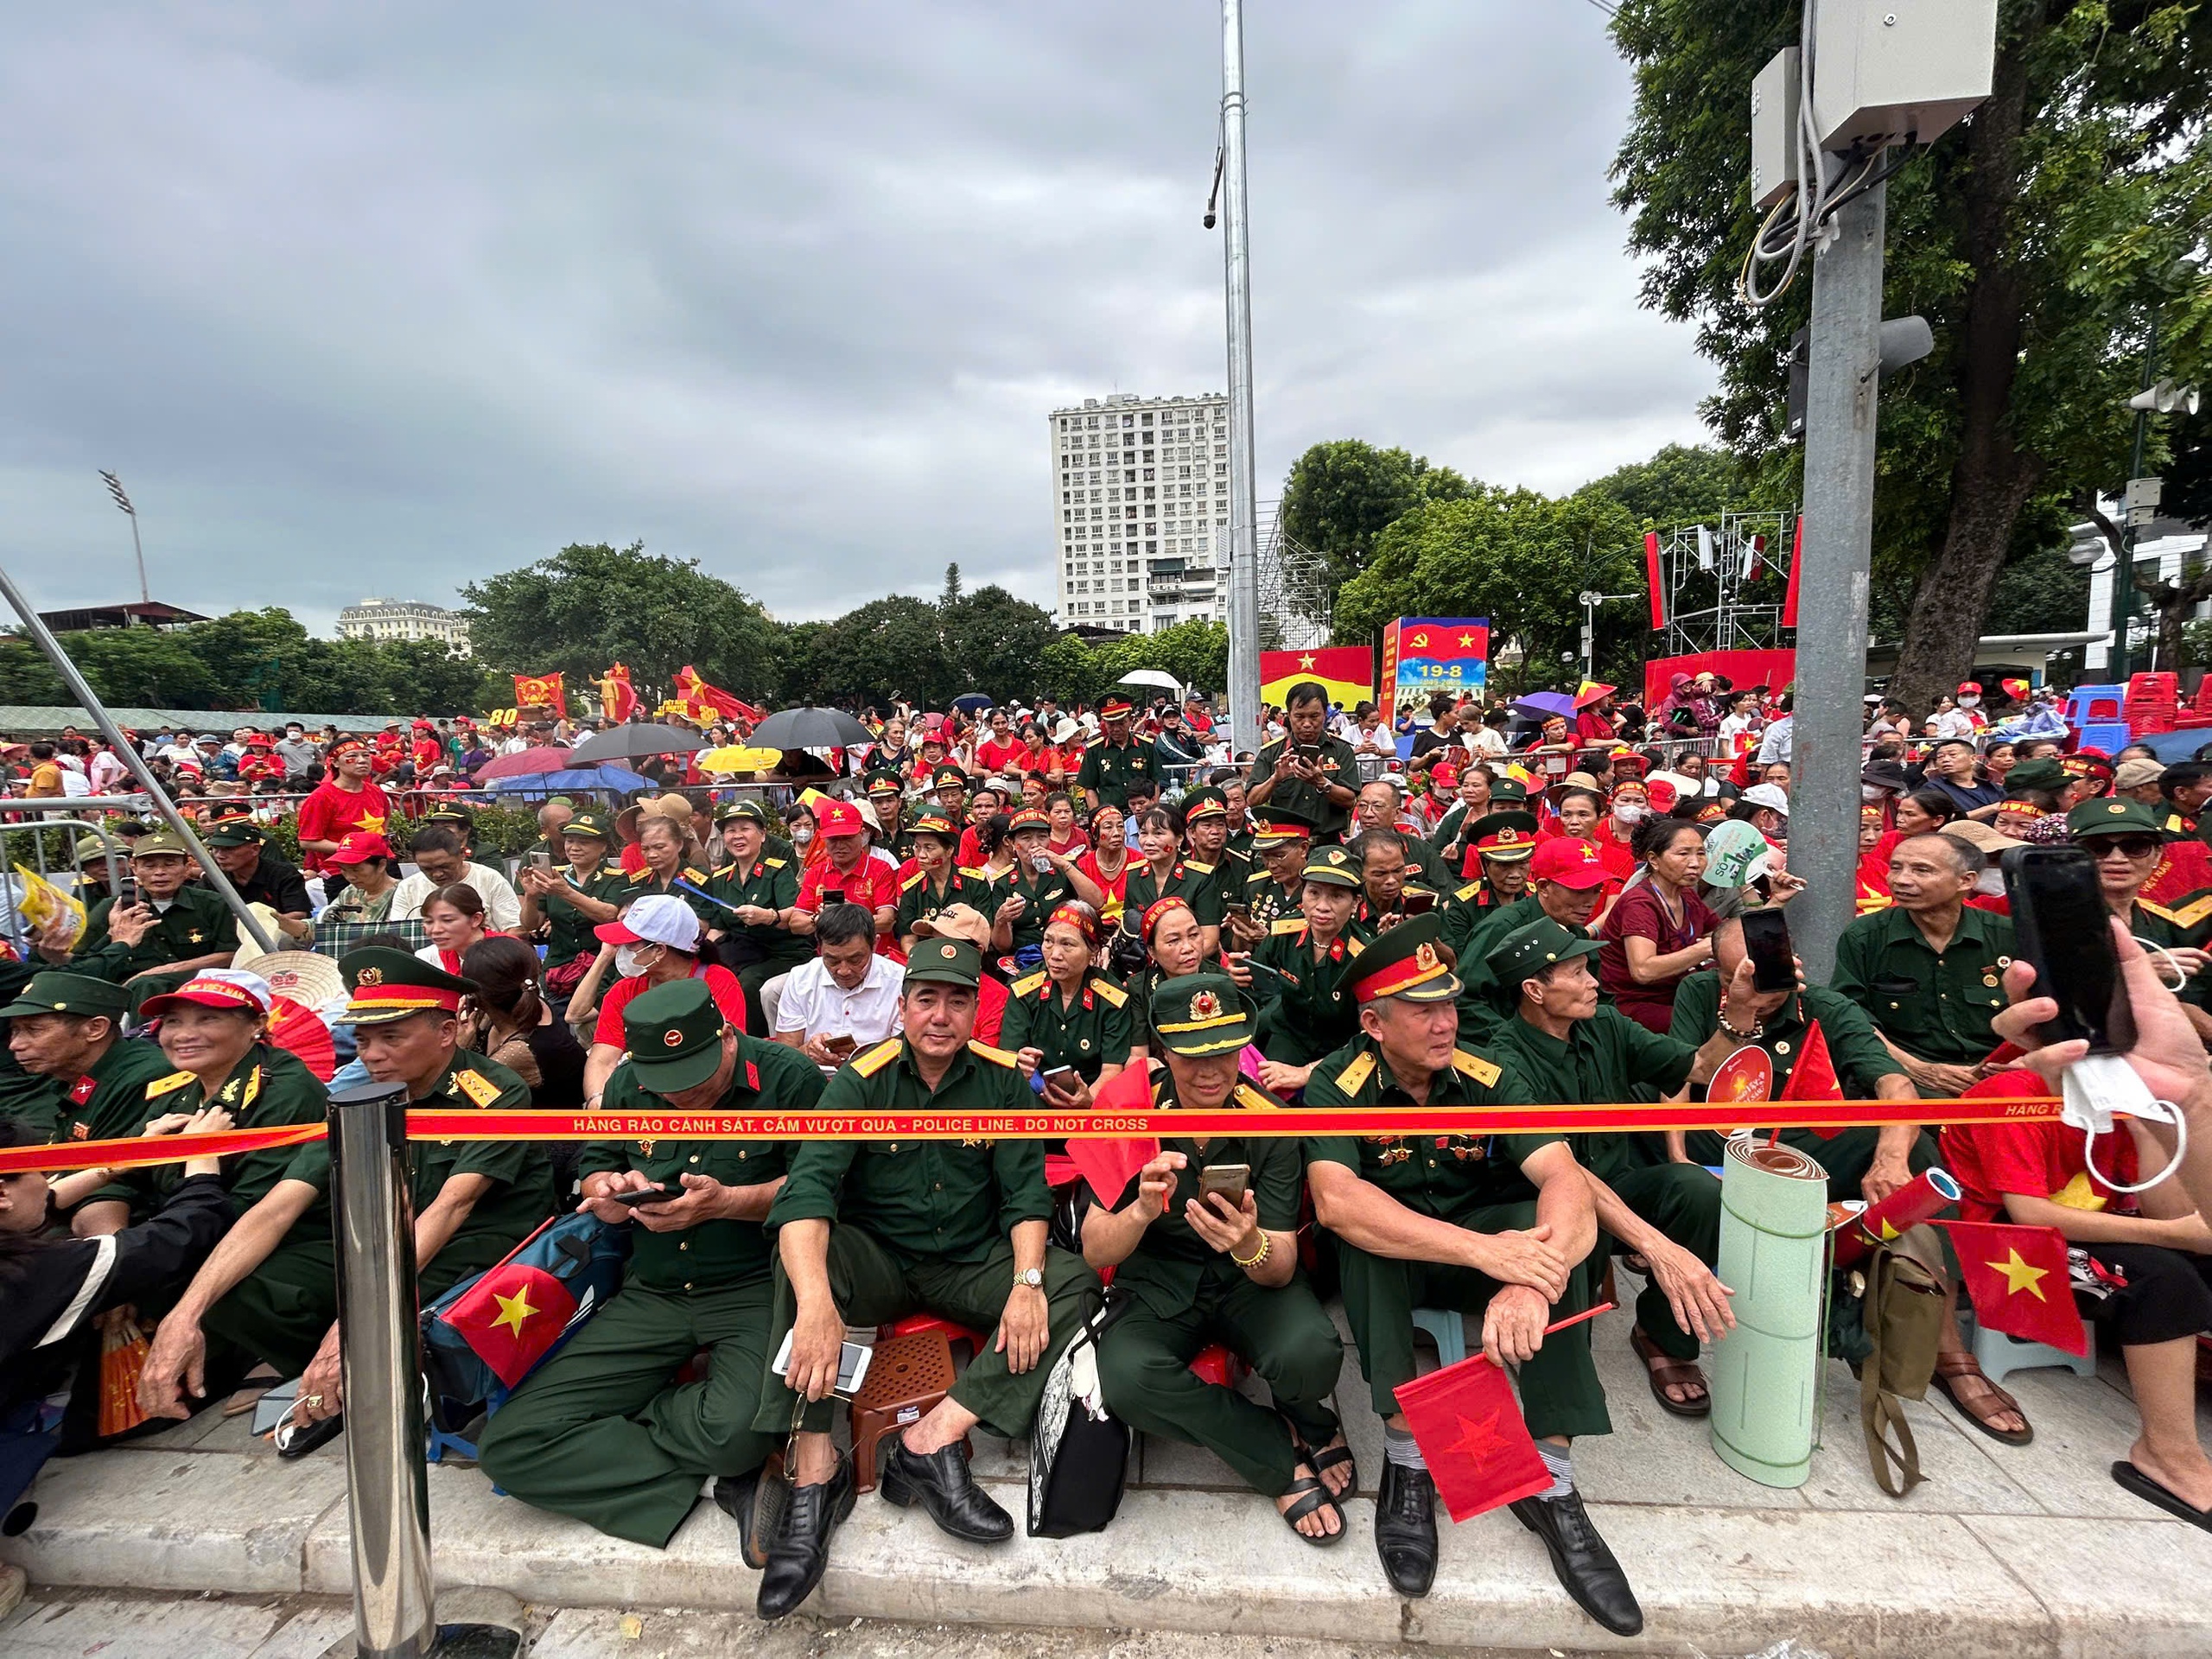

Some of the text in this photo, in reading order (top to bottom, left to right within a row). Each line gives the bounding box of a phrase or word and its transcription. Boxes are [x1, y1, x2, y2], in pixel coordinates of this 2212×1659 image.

[1421, 664, 1462, 677] 19-8
[488, 708, 518, 725] 80
[2005, 1103, 2049, 1116] HÀNG
[573, 1116, 621, 1131] HÀNG
[627, 1116, 664, 1131] RÀO
[721, 1116, 758, 1131] SÁT.
[806, 1119, 855, 1134] VƯỢT
[861, 1119, 897, 1132] QUA
[912, 1119, 973, 1131] POLICE
[977, 1118, 1020, 1131] LINE.
[1025, 1118, 1048, 1131] DO
[1053, 1118, 1088, 1131] NOT
[1091, 1118, 1148, 1130] CROSS
